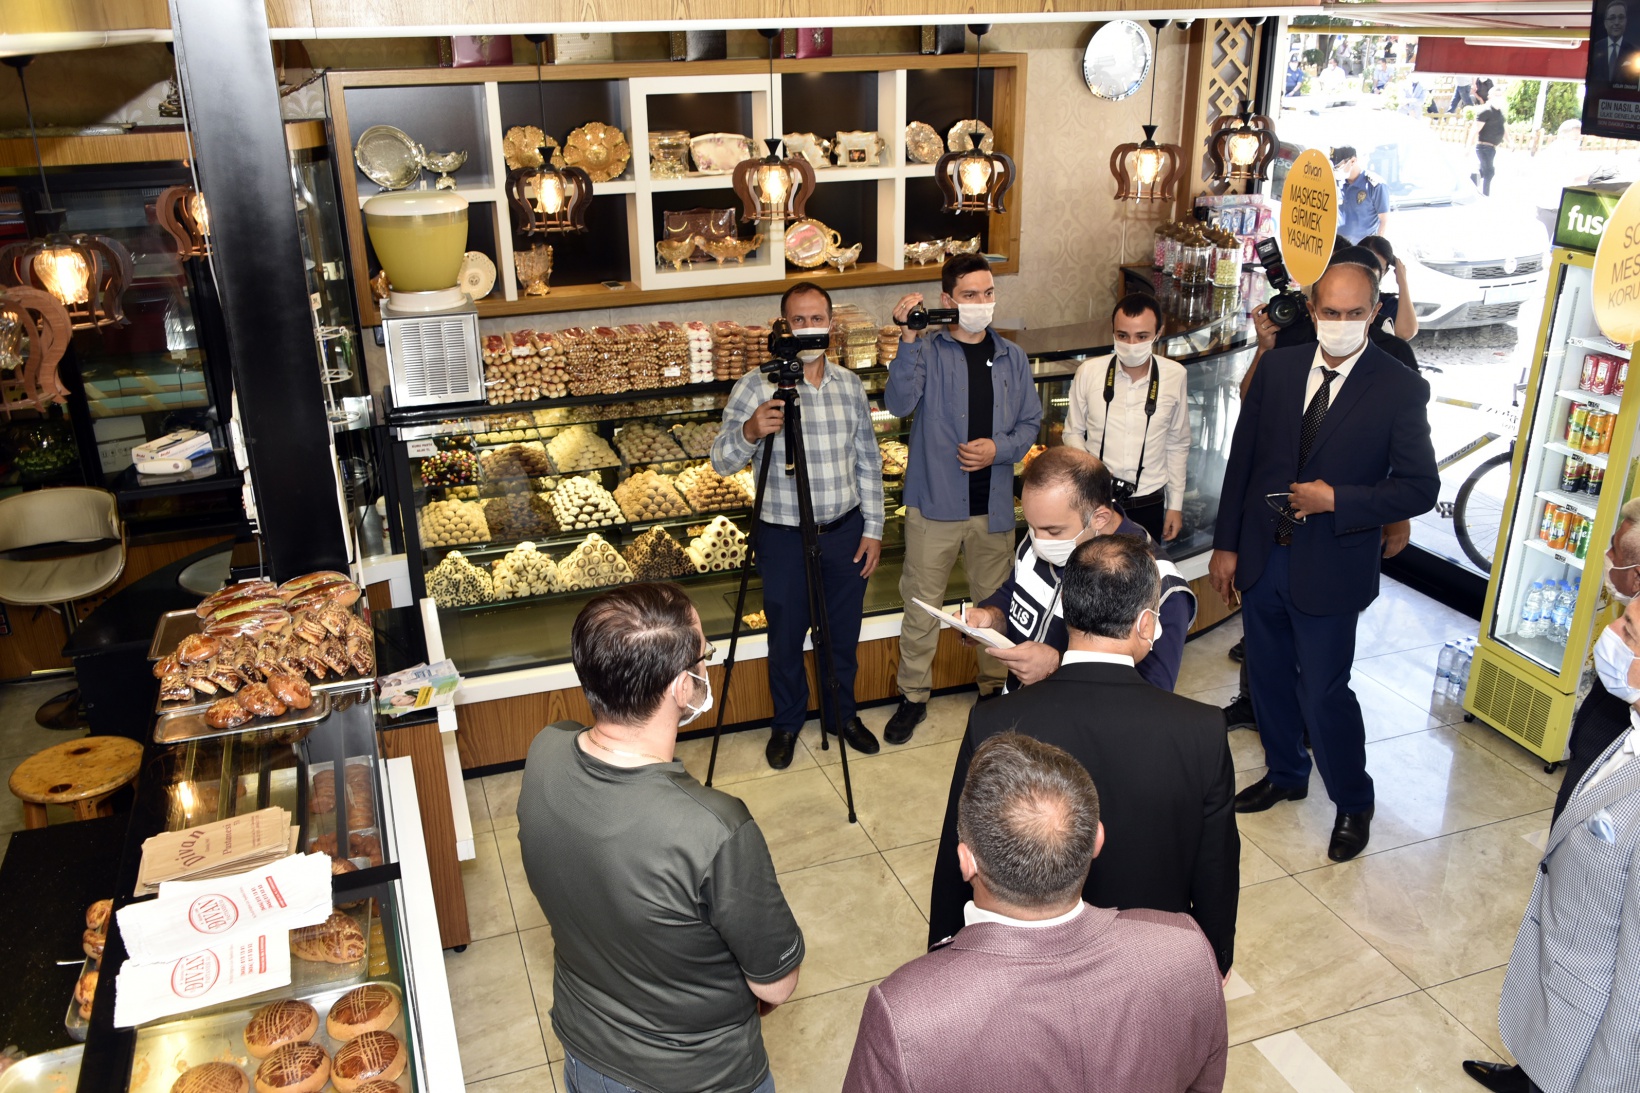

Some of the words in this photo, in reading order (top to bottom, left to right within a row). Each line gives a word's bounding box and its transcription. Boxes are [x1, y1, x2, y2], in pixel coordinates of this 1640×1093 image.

[1303, 161, 1322, 178] divan
[1290, 184, 1330, 212] MASKESİZ
[1291, 205, 1323, 232] GİRMEK
[1287, 227, 1324, 256] YASAKTIR
